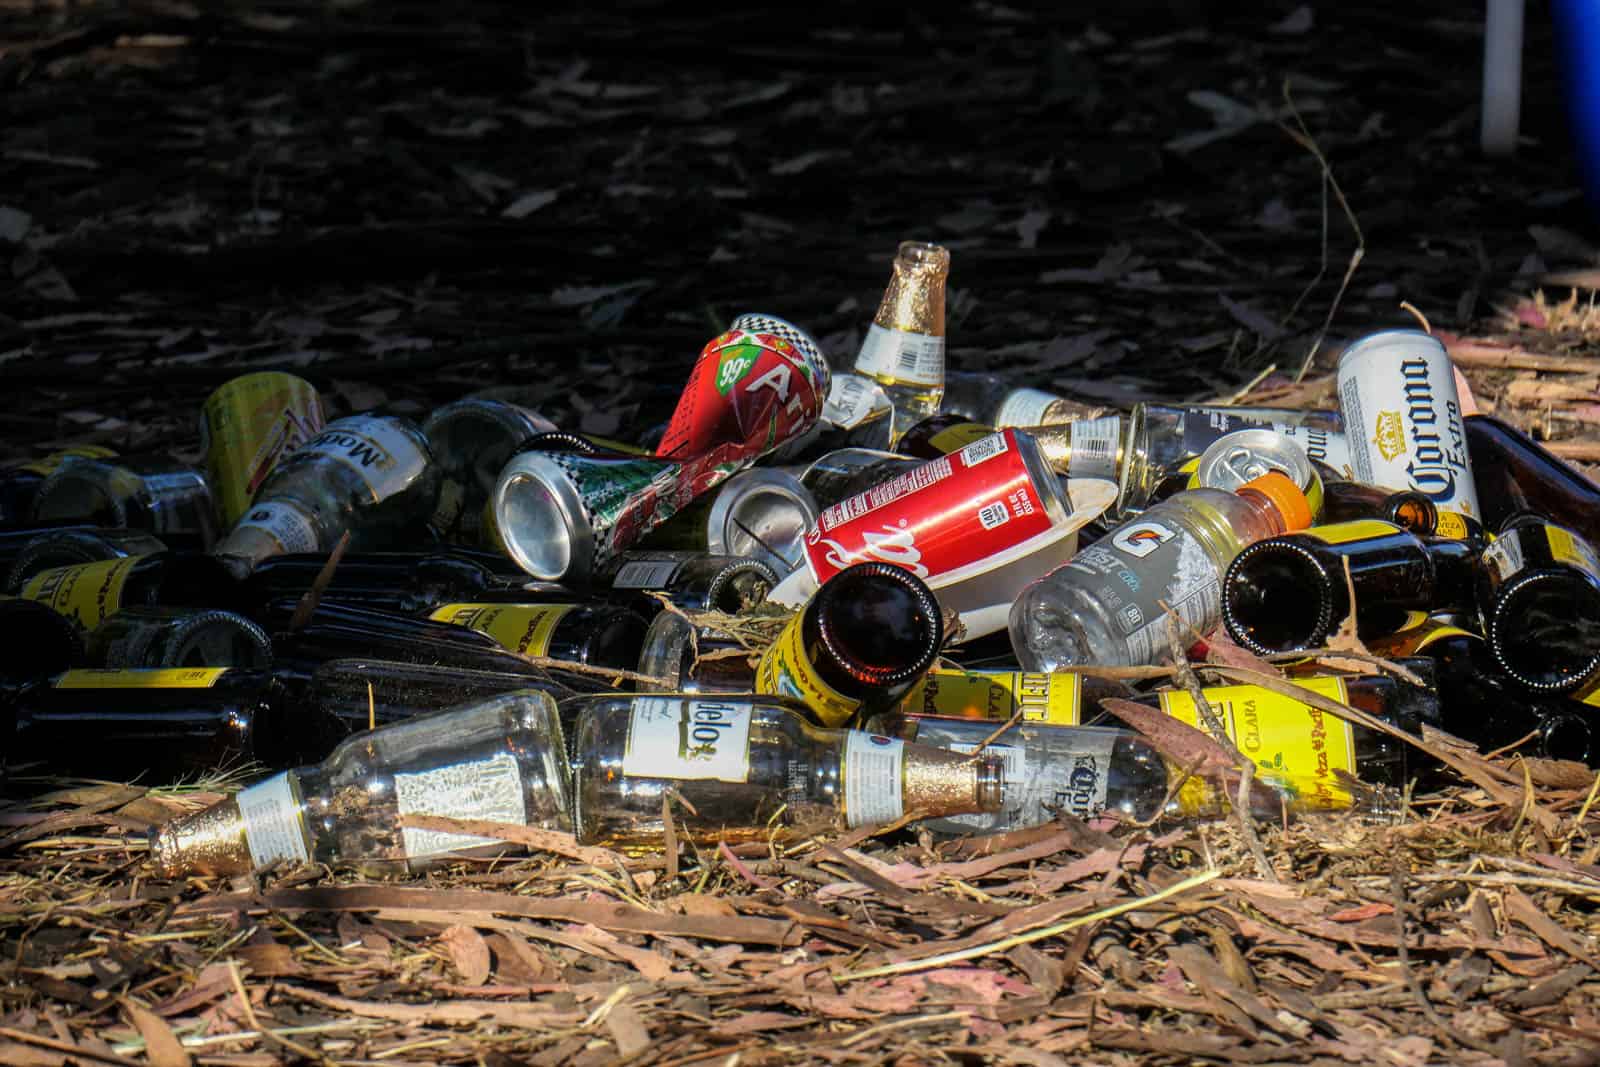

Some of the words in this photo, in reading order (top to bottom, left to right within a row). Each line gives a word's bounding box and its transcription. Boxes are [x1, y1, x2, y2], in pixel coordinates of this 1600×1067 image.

[1400, 357, 1457, 502] Corona
[1445, 400, 1467, 472] Extra
[980, 504, 997, 526] 140
[1112, 522, 1177, 558] G
[1127, 607, 1142, 625] 80
[692, 703, 735, 742] delo
[1244, 699, 1261, 752] CLARA
